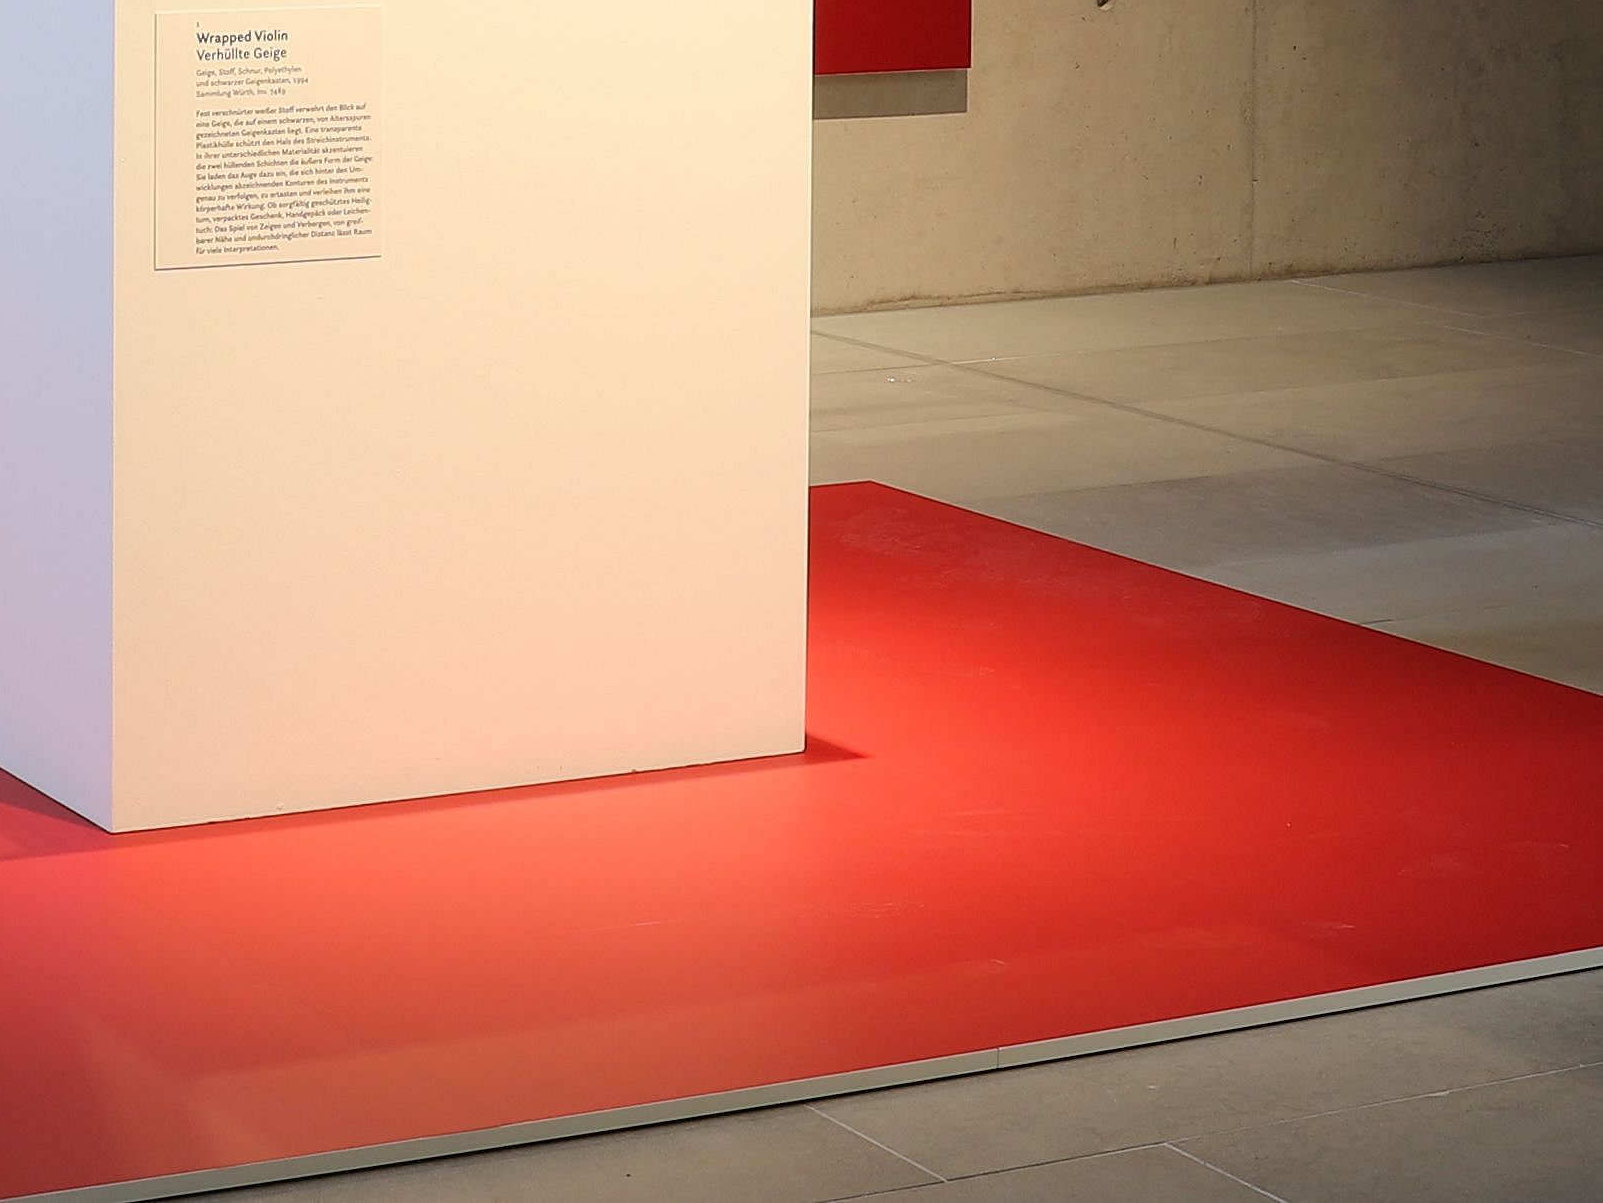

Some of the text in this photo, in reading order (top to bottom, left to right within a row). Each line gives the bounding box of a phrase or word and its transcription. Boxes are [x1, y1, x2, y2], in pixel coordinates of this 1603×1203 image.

[196, 29, 289, 46] Wrapped Violin
[196, 47, 287, 62] Verhüllte Geige
